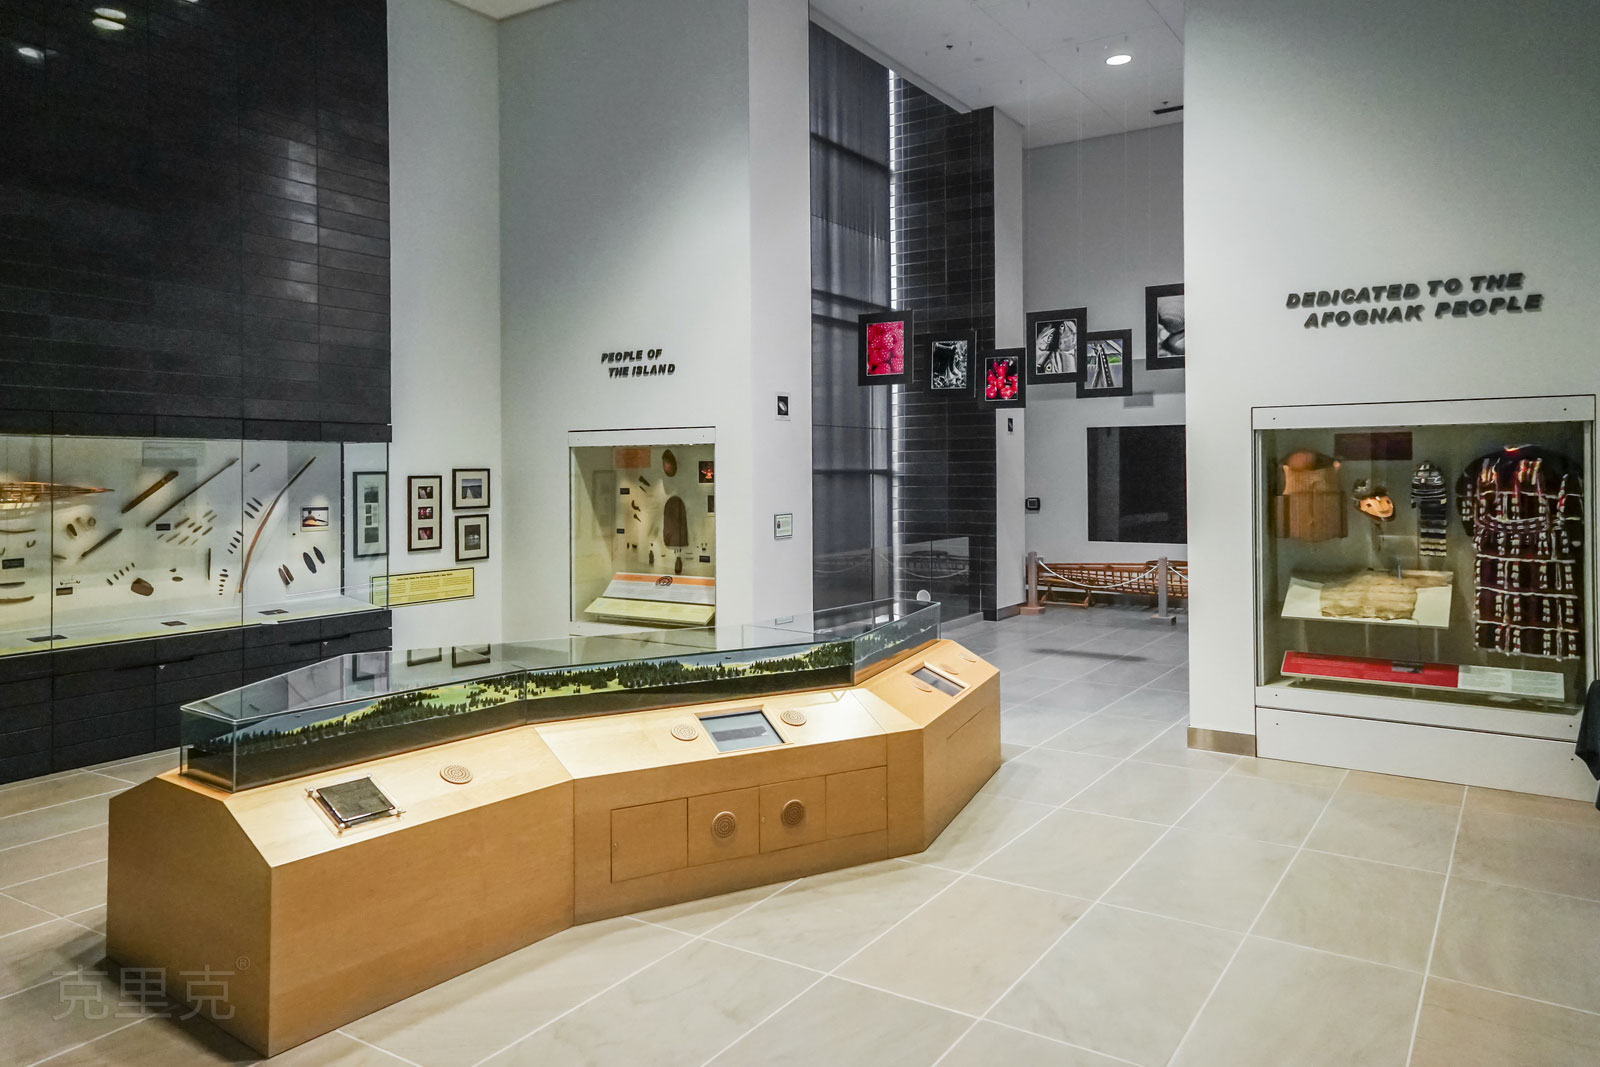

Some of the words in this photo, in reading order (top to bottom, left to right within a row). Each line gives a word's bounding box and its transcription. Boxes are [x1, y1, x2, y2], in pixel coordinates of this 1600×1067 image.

[1286, 283, 1420, 309] DEDICATED
[1427, 278, 1462, 297] TO
[1470, 272, 1524, 293] THE
[1304, 304, 1425, 329] AFOGNAK
[1434, 294, 1544, 318] PEOPLE
[601, 350, 643, 364] PEOPLE
[647, 349, 662, 360] OF
[608, 366, 629, 379] THE
[632, 364, 675, 377] ISLAND
